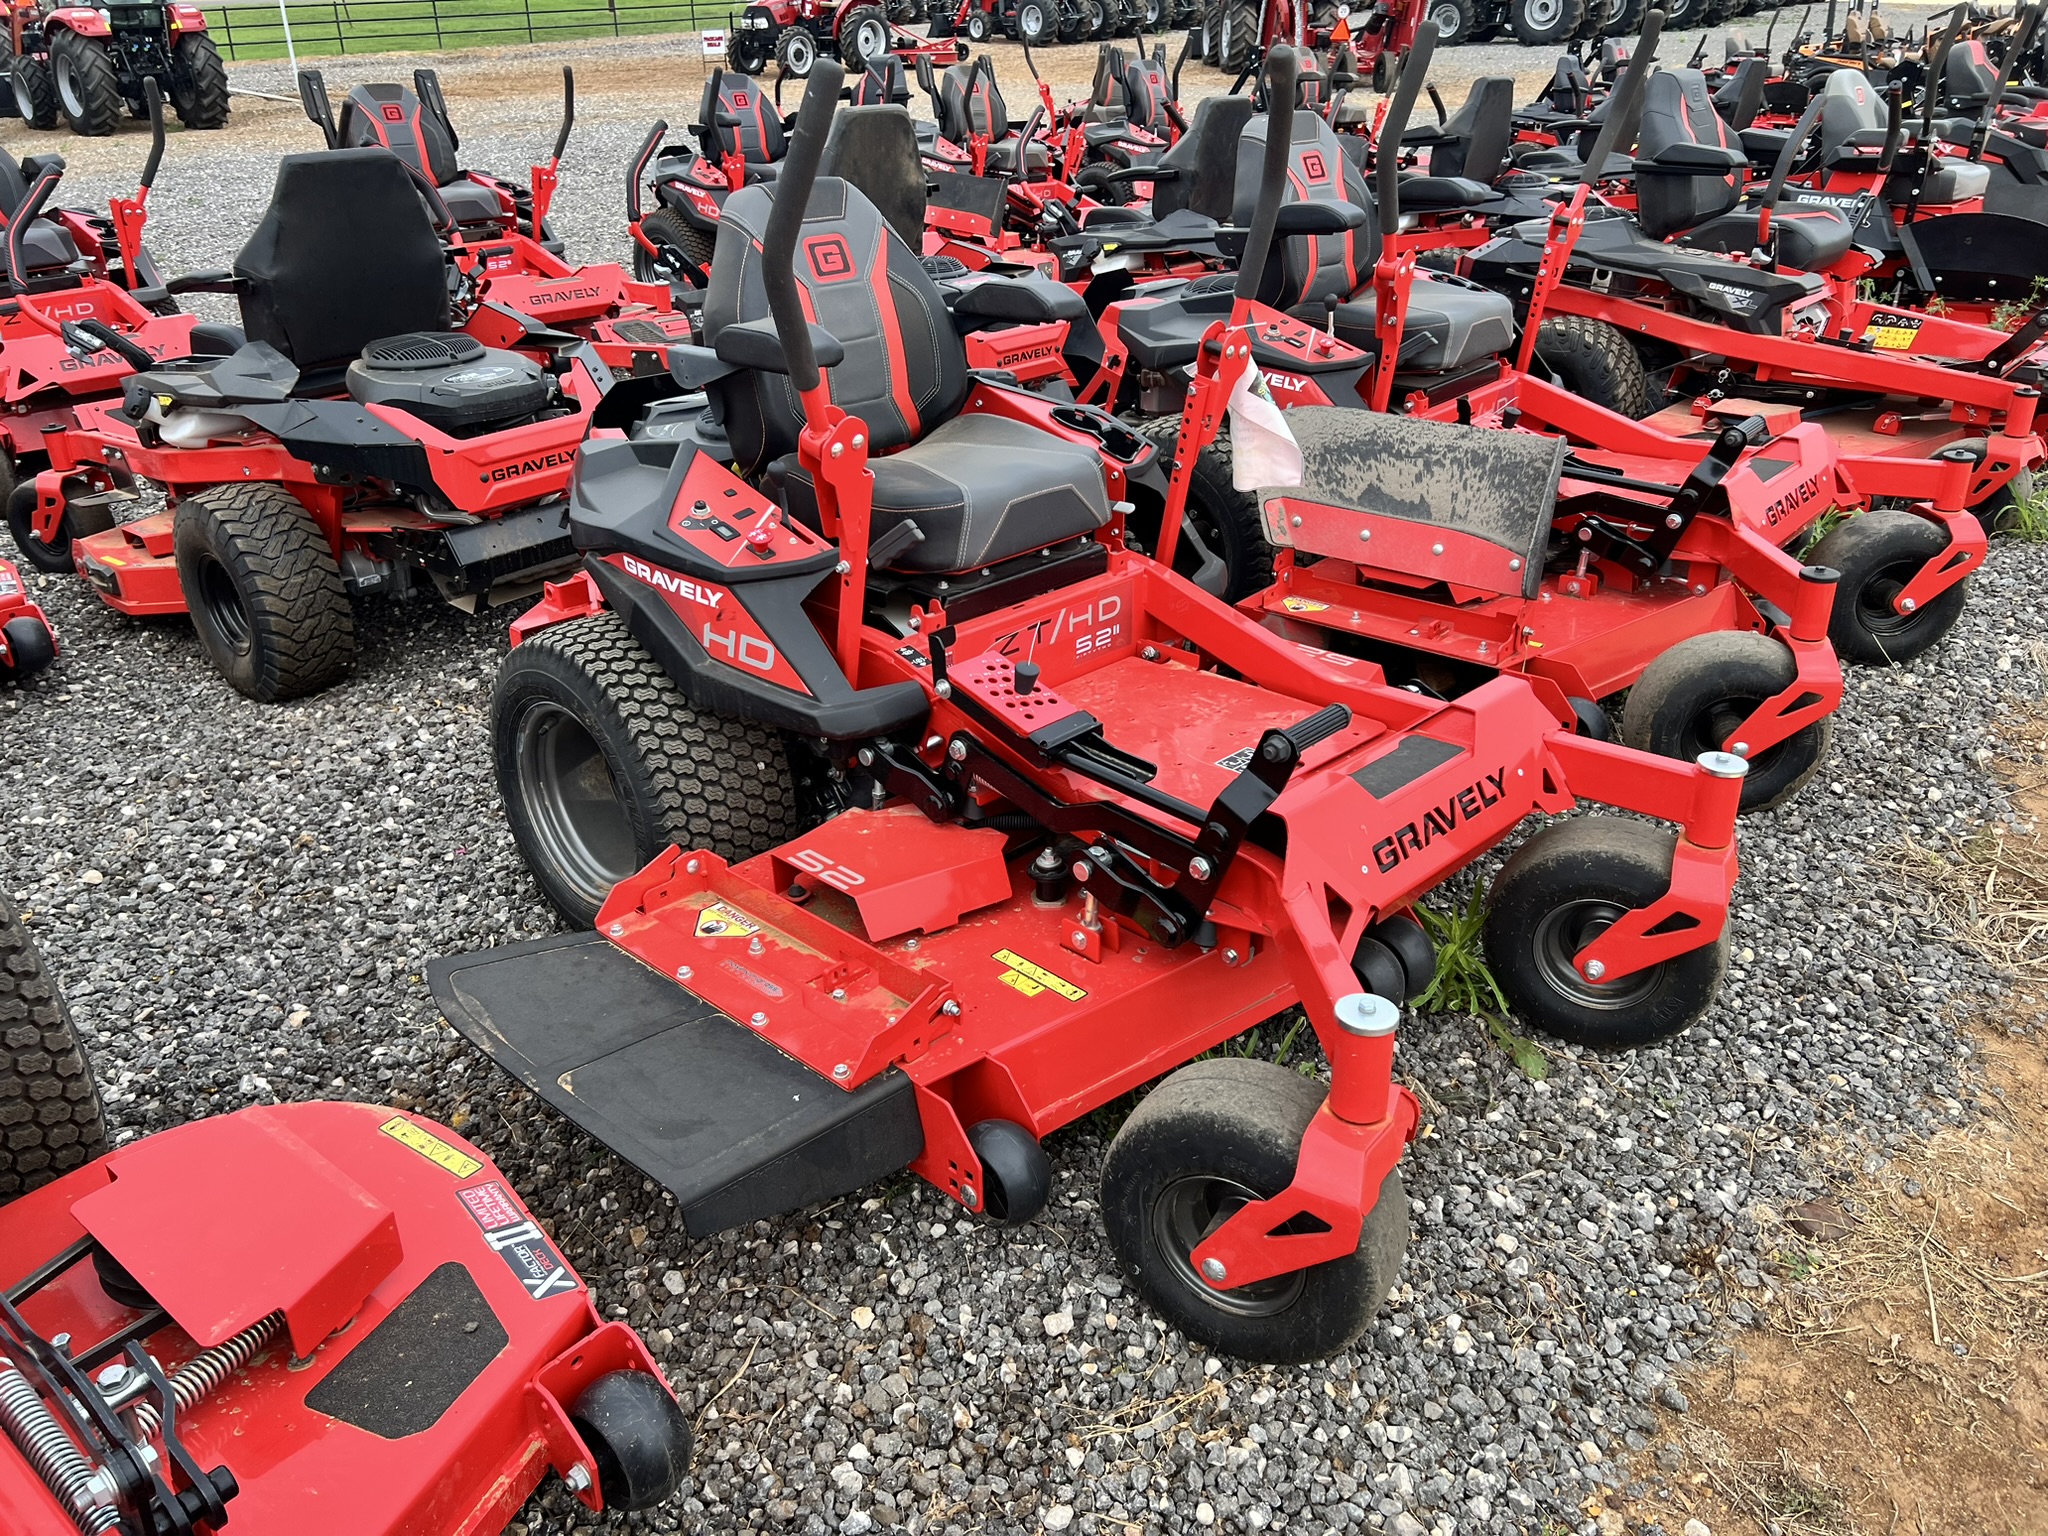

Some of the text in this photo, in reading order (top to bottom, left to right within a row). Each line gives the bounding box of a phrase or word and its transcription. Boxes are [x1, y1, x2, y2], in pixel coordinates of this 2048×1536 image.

[675, 181, 706, 198] GRAVELY
[697, 202, 720, 217] HD
[806, 237, 854, 280] G
[529, 286, 600, 306] GRAVELY
[1708, 282, 1754, 298] GRAVELY
[1733, 297, 1758, 310] XL
[1003, 346, 1053, 365] GRAVELY
[491, 449, 577, 482] GRAVELY
[1765, 475, 1820, 527] GRAVELY
[622, 555, 723, 608] GRAVELY
[703, 622, 775, 671] HD
[1372, 766, 1506, 874] GRAVELY
[787, 849, 866, 890] 52
[717, 904, 756, 930] DANGER
[463, 1190, 499, 1230] LIMITED
[474, 1187, 510, 1226] LIFETIME
[485, 1184, 522, 1221] WARRANTY
[514, 1245, 543, 1278] FACTOR
[532, 1248, 554, 1270] DECK
